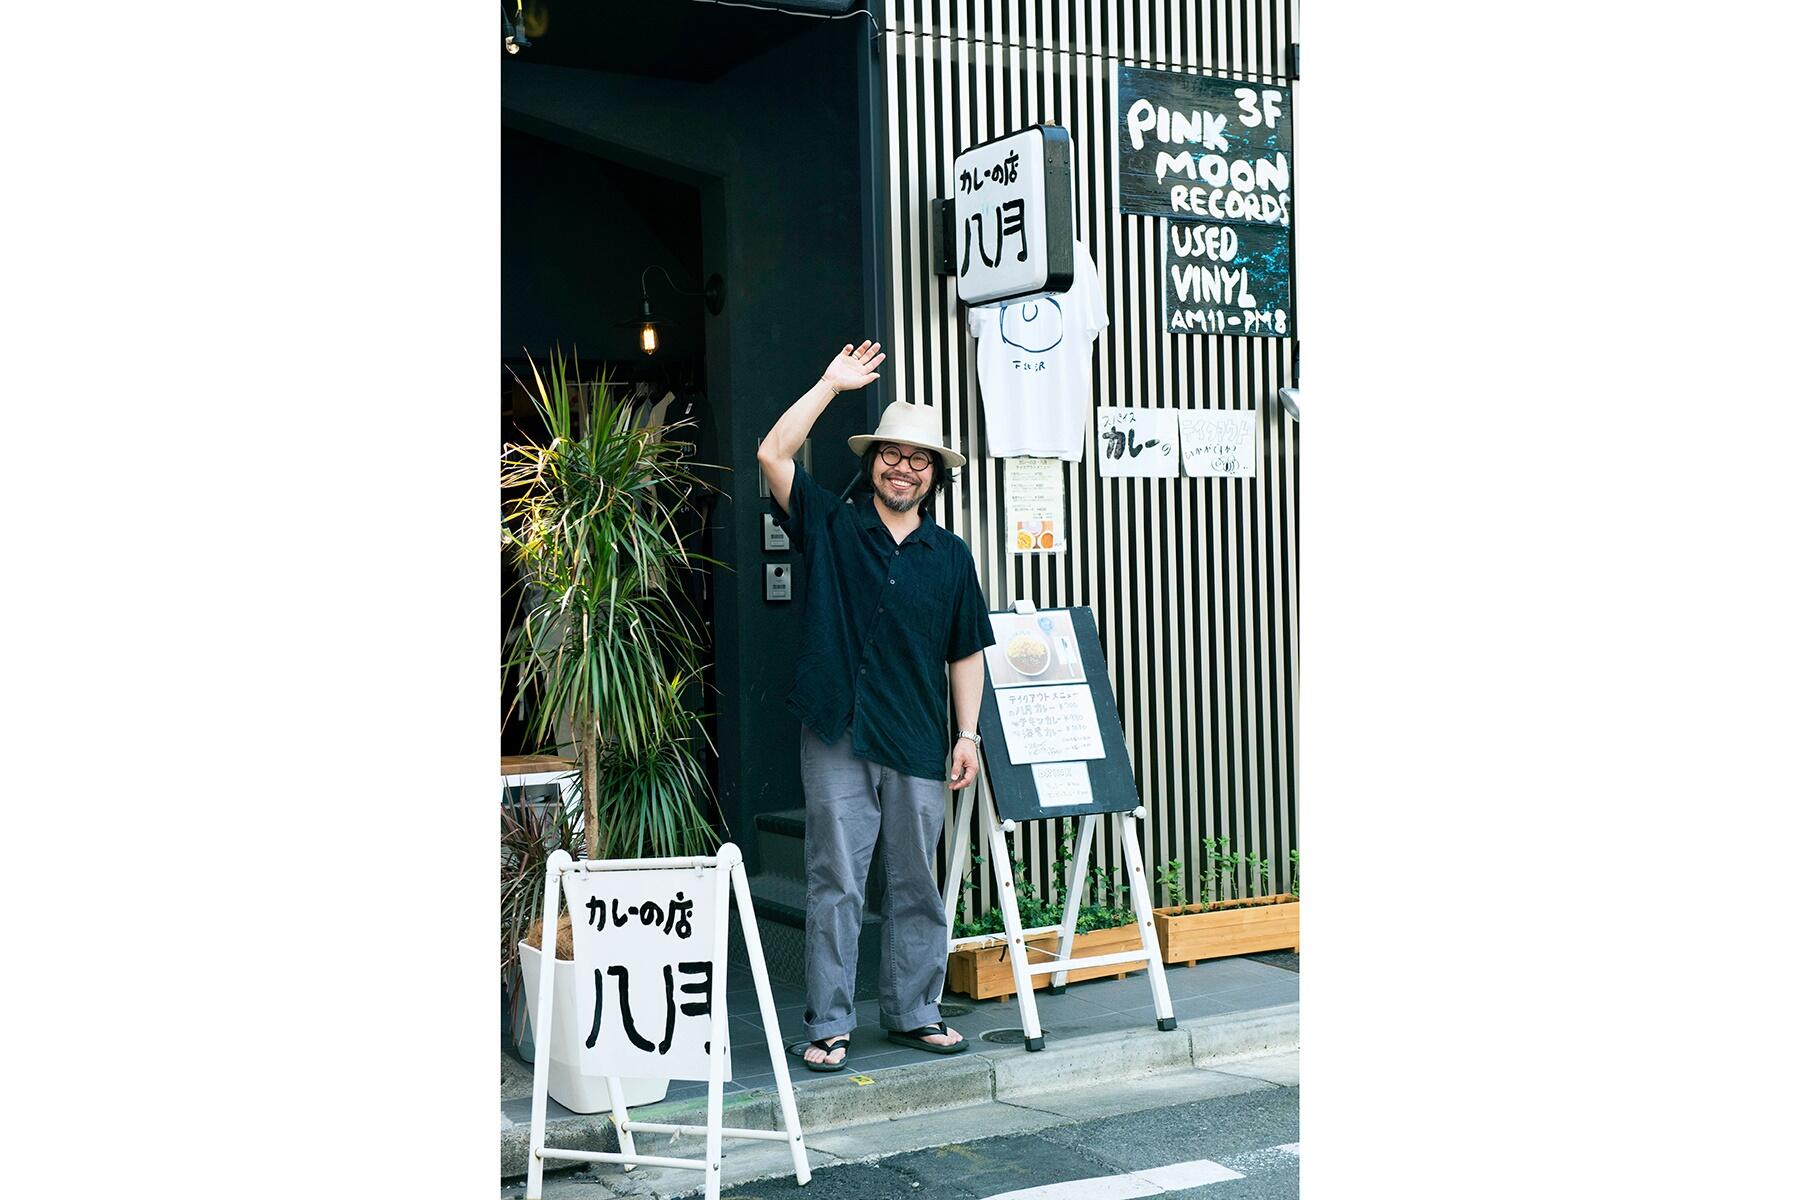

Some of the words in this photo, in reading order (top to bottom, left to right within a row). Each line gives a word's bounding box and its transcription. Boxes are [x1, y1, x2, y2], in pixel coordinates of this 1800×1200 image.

[1127, 98, 1229, 152] PINK
[1234, 87, 1282, 128] 3F
[959, 149, 1020, 195] カレーの店
[1155, 151, 1290, 193] MOON
[1170, 185, 1291, 226] RECORDS
[961, 198, 1028, 278] 八月
[1171, 225, 1238, 262] USED
[1171, 264, 1256, 308] VINYL
[585, 891, 693, 939] カレーの店
[585, 961, 726, 1055] 八月
